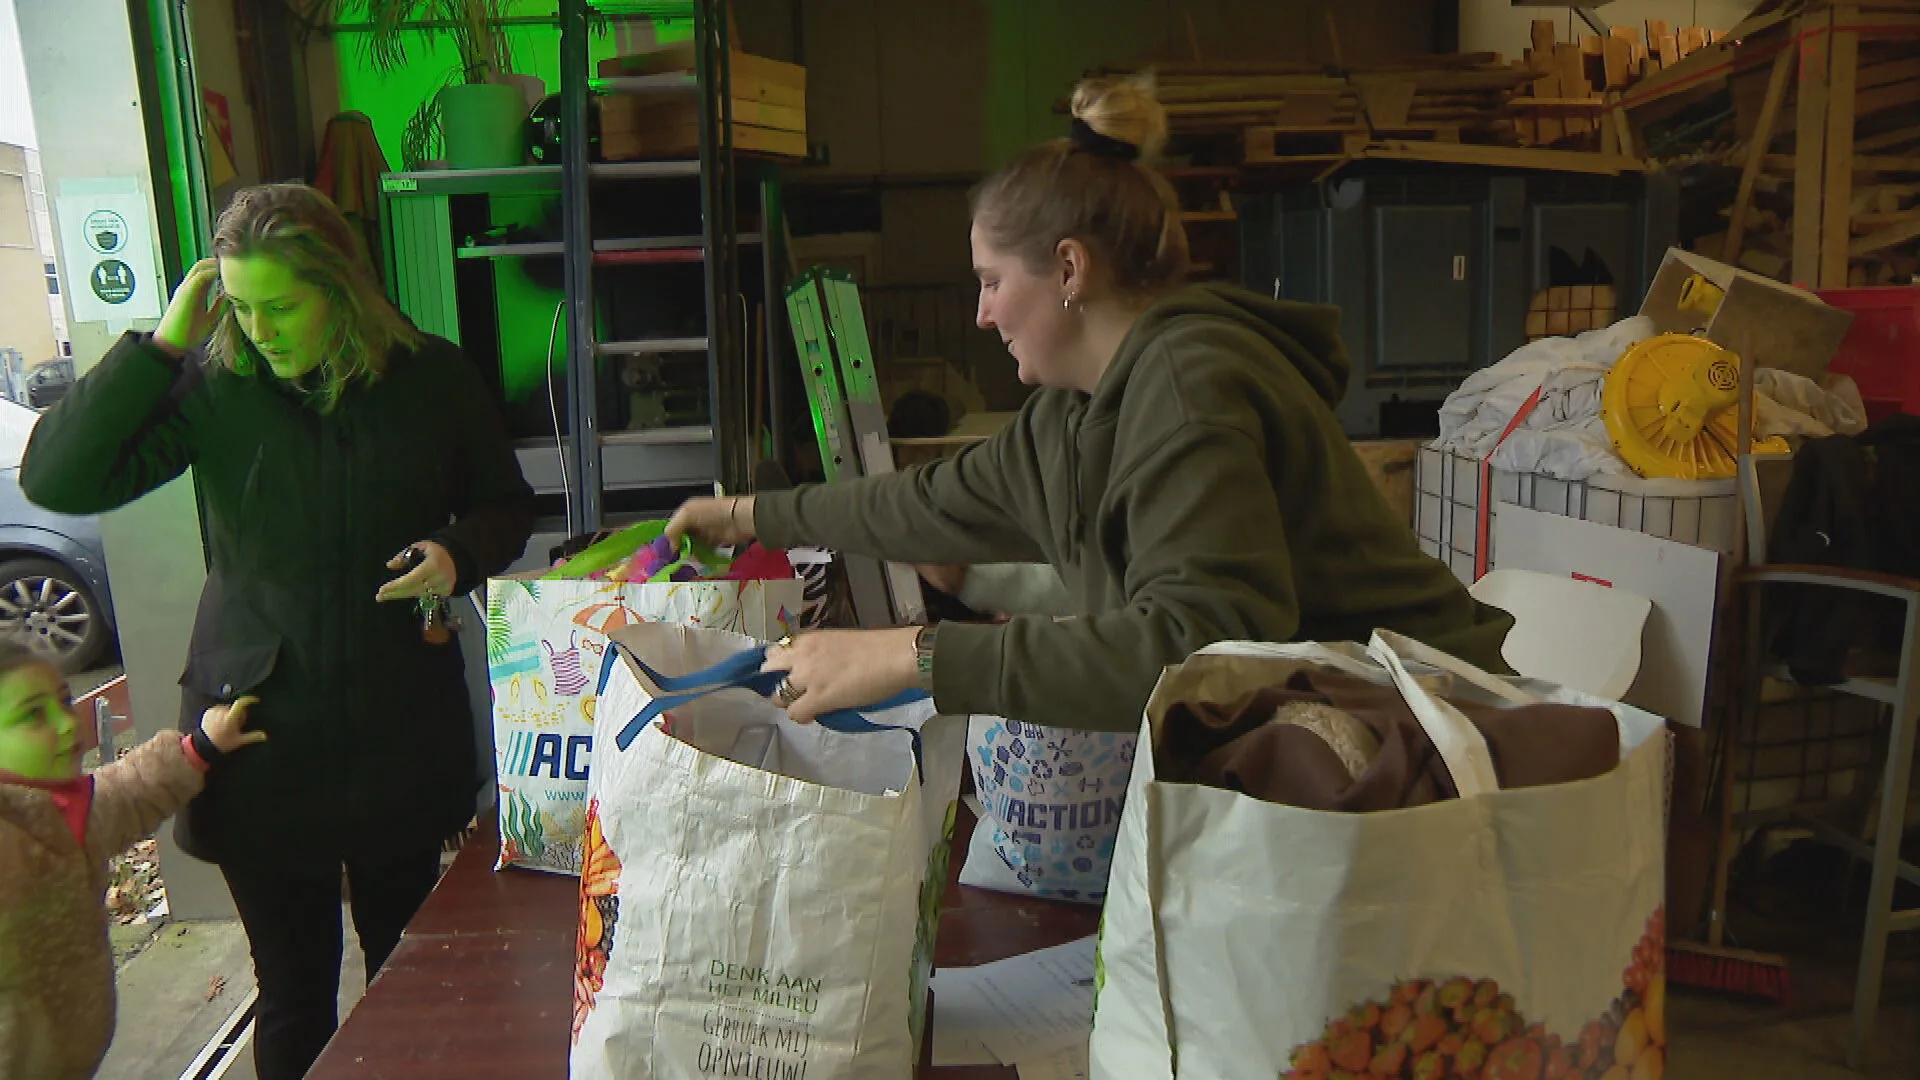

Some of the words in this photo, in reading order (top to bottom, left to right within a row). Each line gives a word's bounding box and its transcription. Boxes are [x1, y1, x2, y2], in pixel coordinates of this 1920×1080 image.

[1006, 798, 1122, 830] ACTION
[711, 959, 769, 985] DENK
[776, 973, 821, 993] AAN
[708, 979, 742, 997] HET
[753, 986, 818, 1014] MILIEU
[703, 1009, 768, 1049] GEBRUIK
[774, 1025, 810, 1059] MIJ
